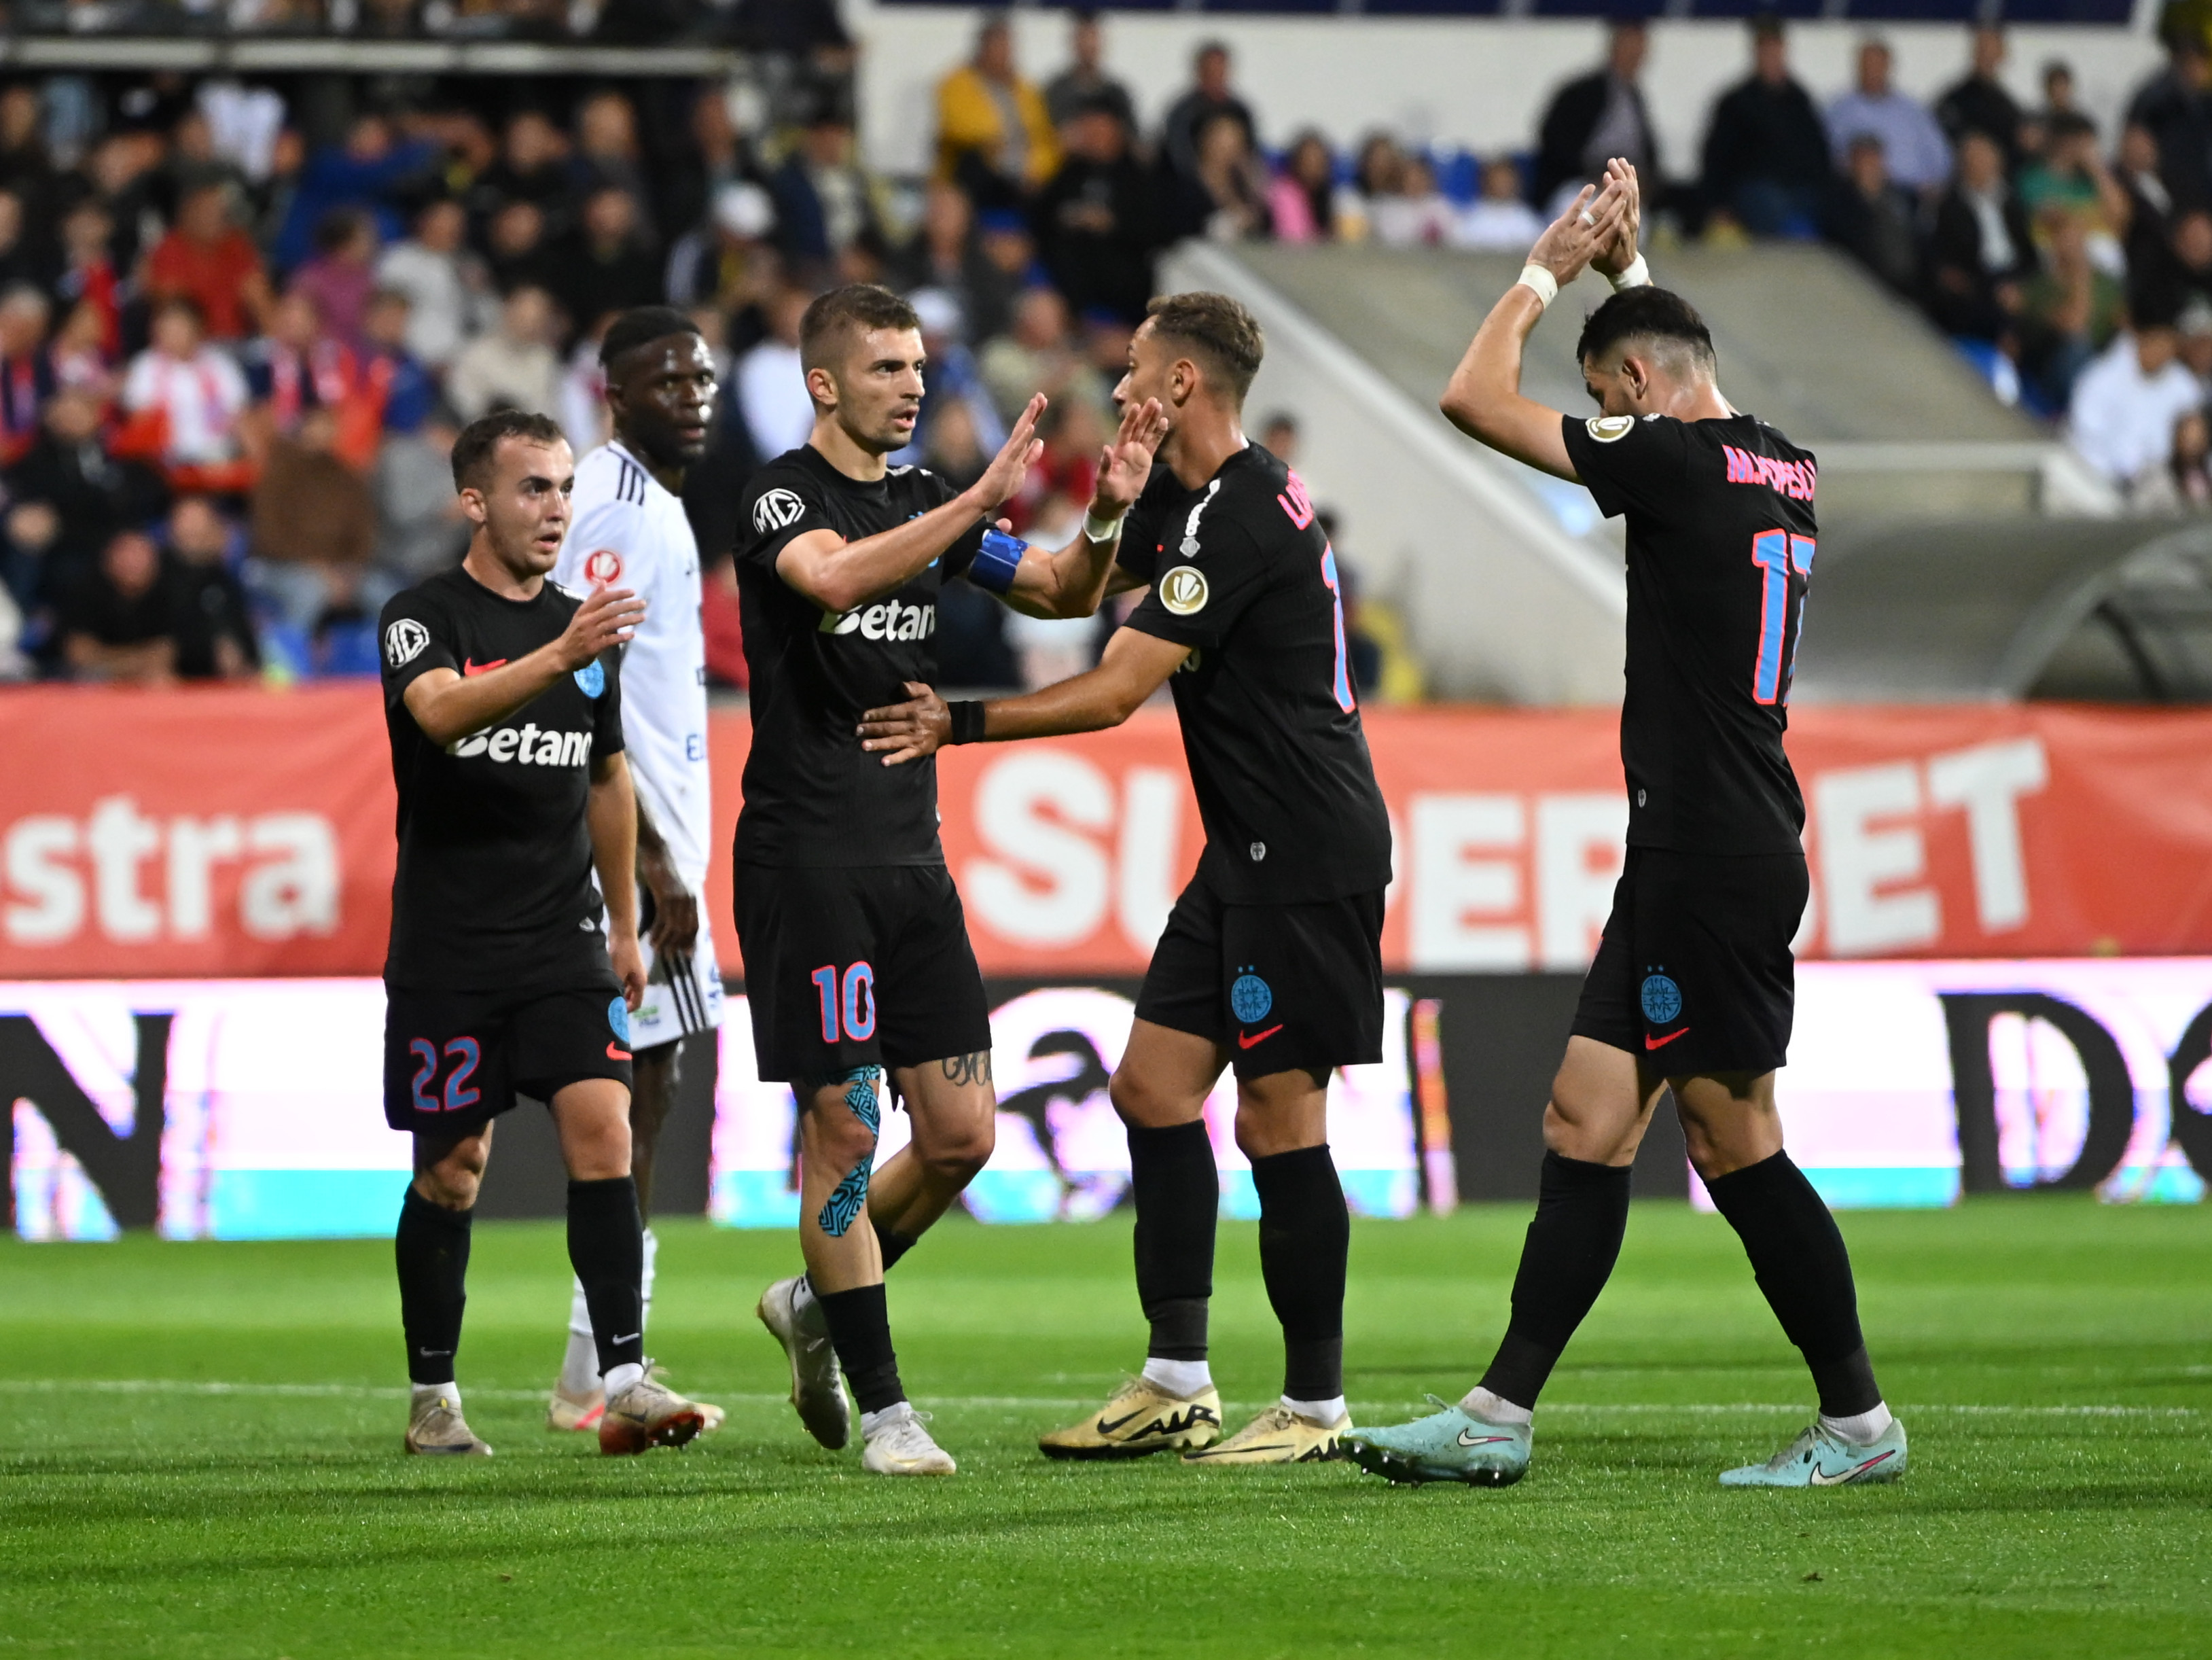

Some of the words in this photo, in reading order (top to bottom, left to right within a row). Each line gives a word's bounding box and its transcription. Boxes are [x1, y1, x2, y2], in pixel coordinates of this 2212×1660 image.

[753, 488, 806, 535] MG
[385, 618, 430, 669] MG
[5, 792, 341, 944] stra
[811, 961, 876, 1044] 10
[410, 1036, 480, 1112] 22
[1122, 1403, 1220, 1435] AIR
